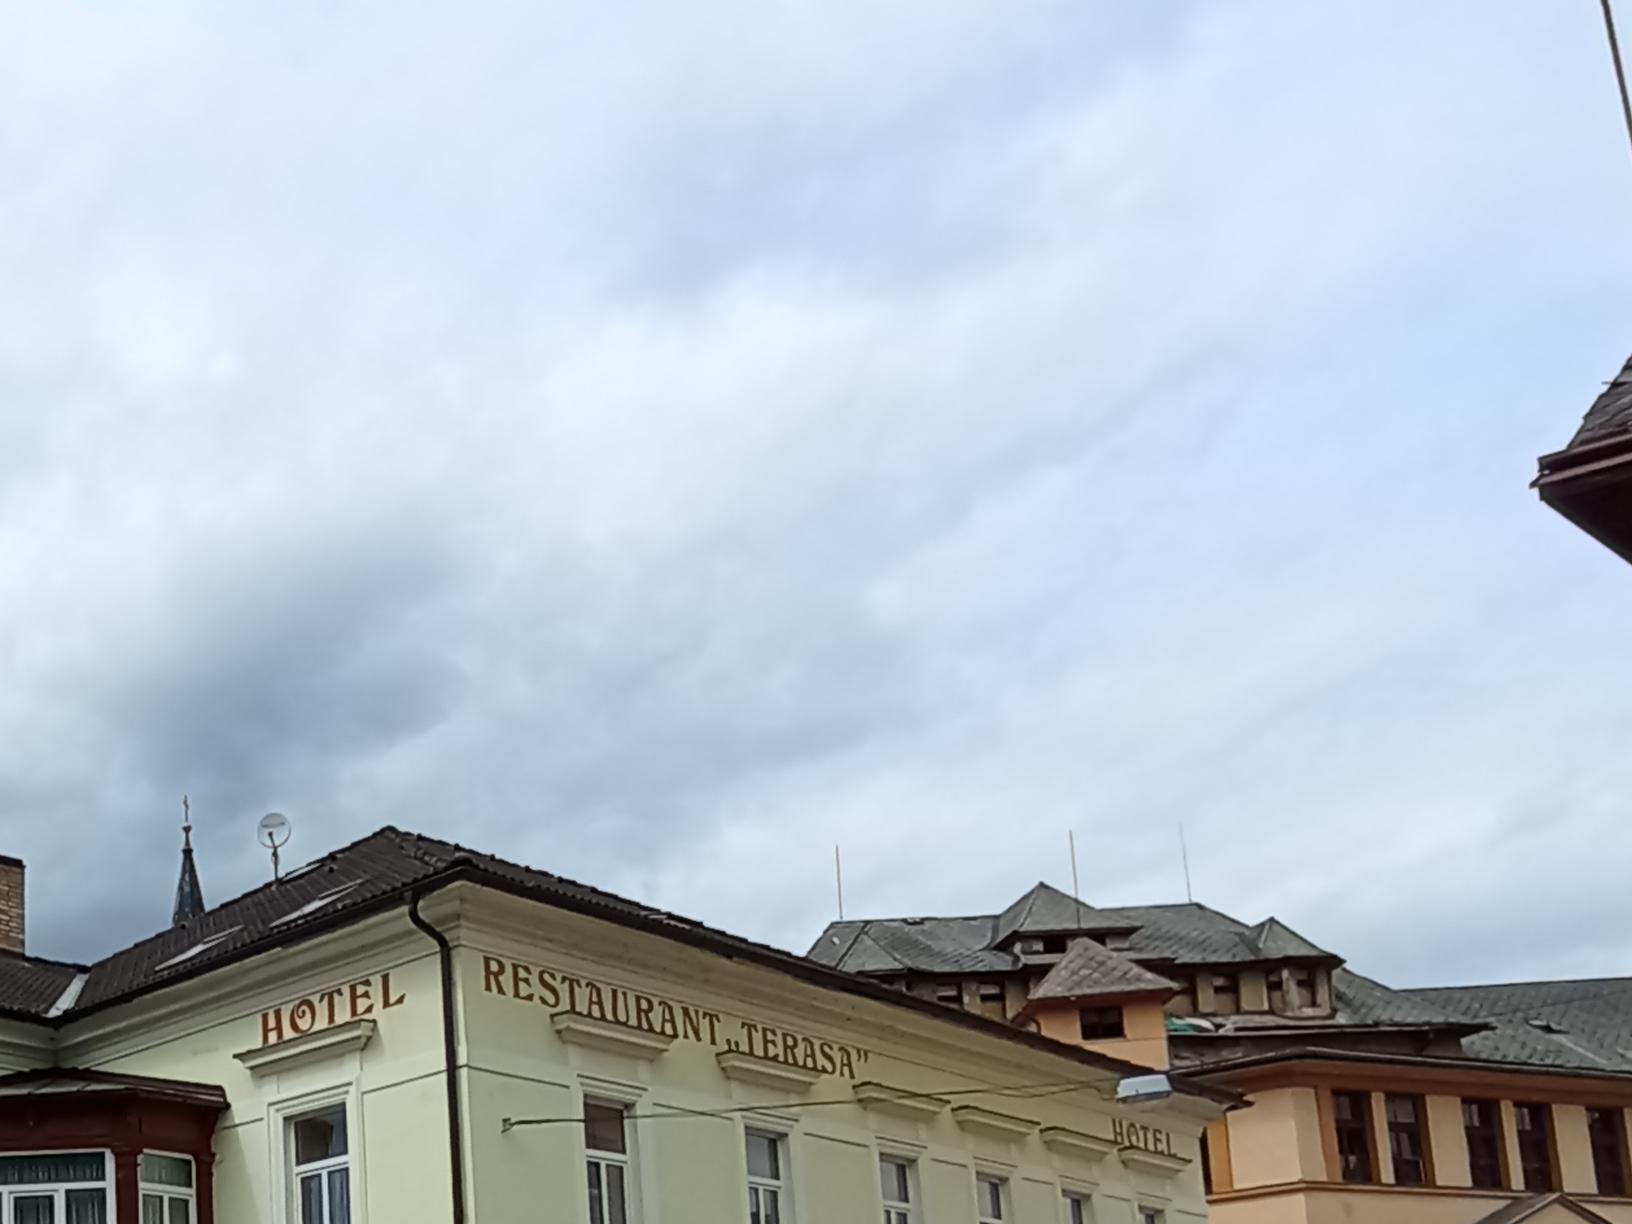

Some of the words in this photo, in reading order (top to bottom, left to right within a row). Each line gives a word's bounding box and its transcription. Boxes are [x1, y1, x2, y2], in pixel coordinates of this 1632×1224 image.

[260, 973, 407, 1045] HOTEL
[482, 955, 720, 1047] RESTAURANT
[1112, 1118, 1178, 1156] HOTEL
